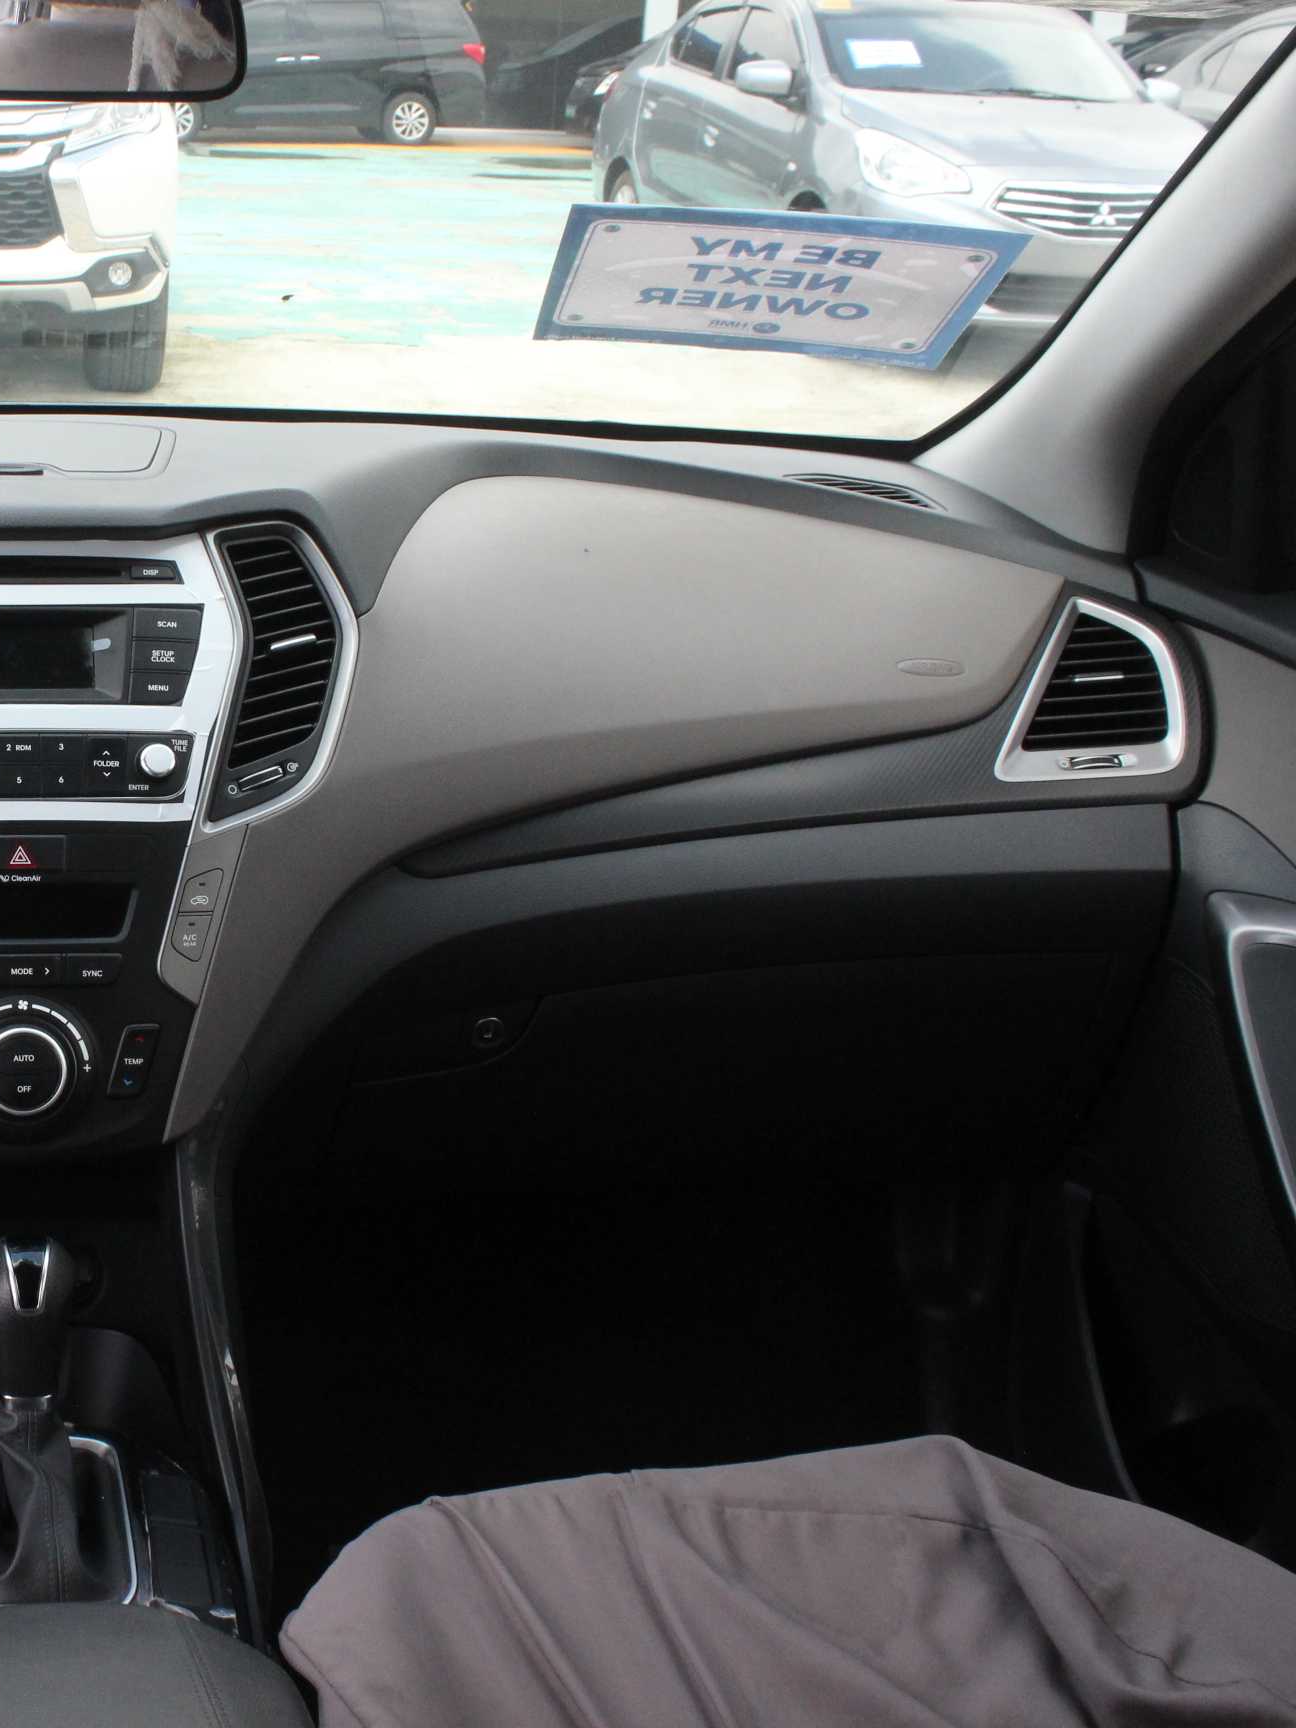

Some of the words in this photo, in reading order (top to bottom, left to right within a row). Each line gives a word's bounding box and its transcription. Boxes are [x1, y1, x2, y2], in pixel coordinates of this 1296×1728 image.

[142, 568, 160, 576] DISP
[156, 620, 178, 628] SCAN
[151, 649, 175, 657] SETUP
[147, 683, 170, 692] MENU
[170, 738, 189, 746] TUNE
[5, 743, 12, 752] 2
[15, 744, 32, 752] RDM
[58, 743, 65, 751] 3
[173, 745, 188, 753] FILE
[93, 760, 121, 768] FOLDER
[16, 776, 22, 784] 5
[57, 776, 64, 784] 6
[127, 784, 150, 792] ENTER
[10, 874, 42, 882] CleanAir
[182, 933, 198, 941] A/C
[10, 967, 34, 976] MODE
[81, 969, 104, 978] SYNC
[13, 1053, 36, 1063] AUTO
[124, 1057, 145, 1066] TEMP
[16, 1084, 33, 1094] OFF
